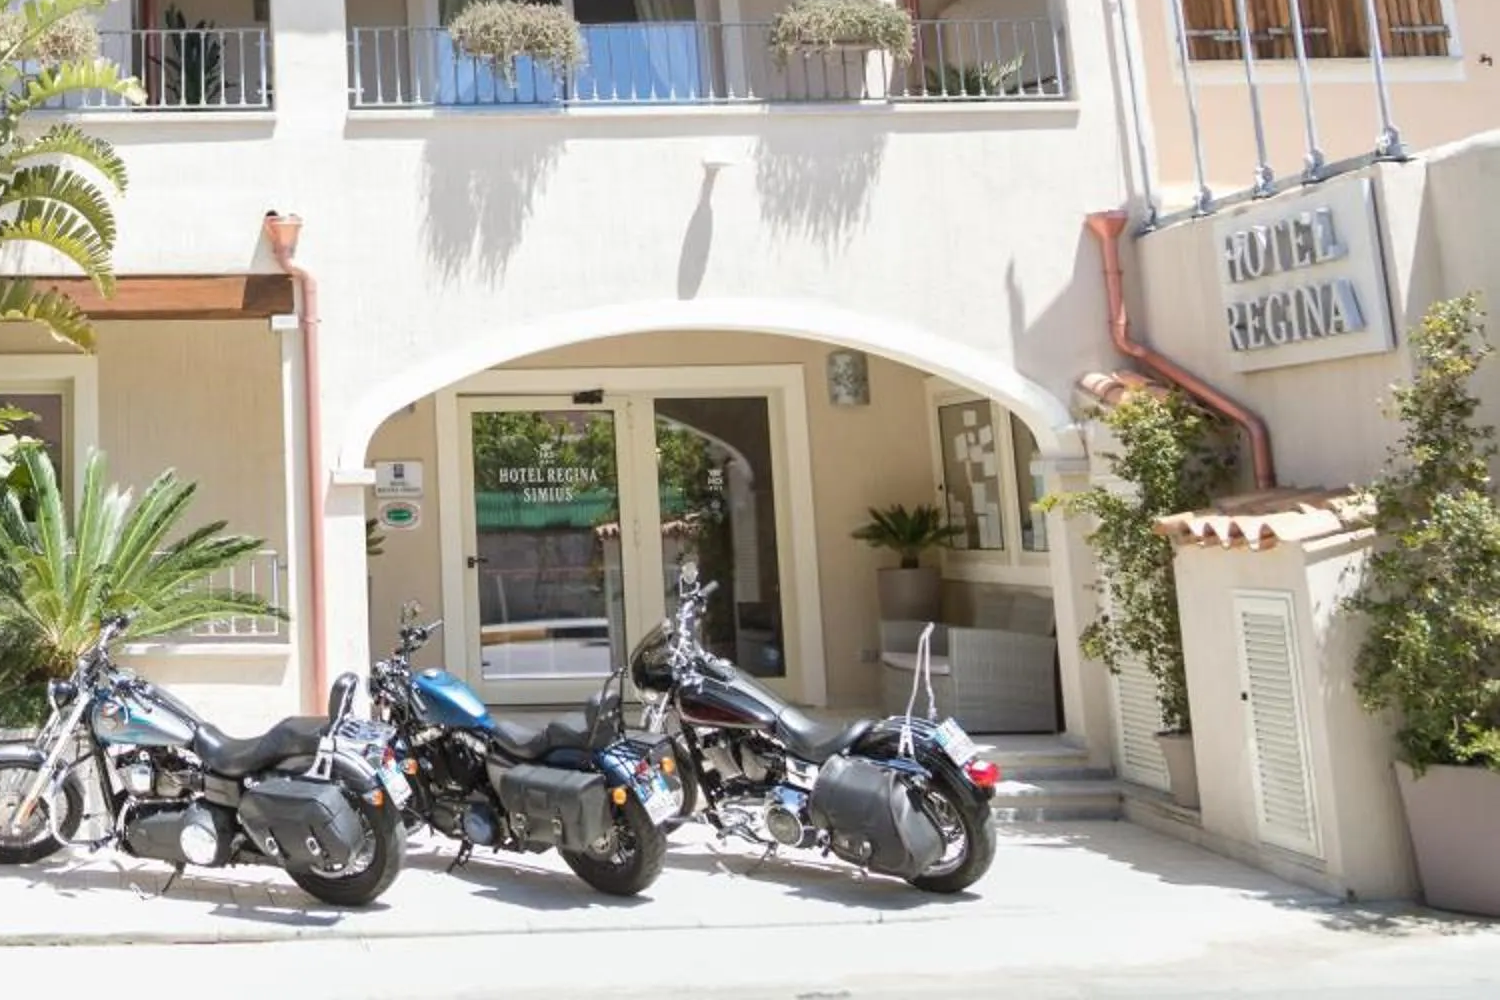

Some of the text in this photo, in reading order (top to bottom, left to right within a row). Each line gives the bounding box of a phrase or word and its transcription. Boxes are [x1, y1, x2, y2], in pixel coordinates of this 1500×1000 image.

[1225, 206, 1349, 282] HOTEL
[1226, 278, 1367, 351] REGINA
[499, 467, 598, 483] HOTEL REGINA
[523, 487, 573, 503] SIMIUS
